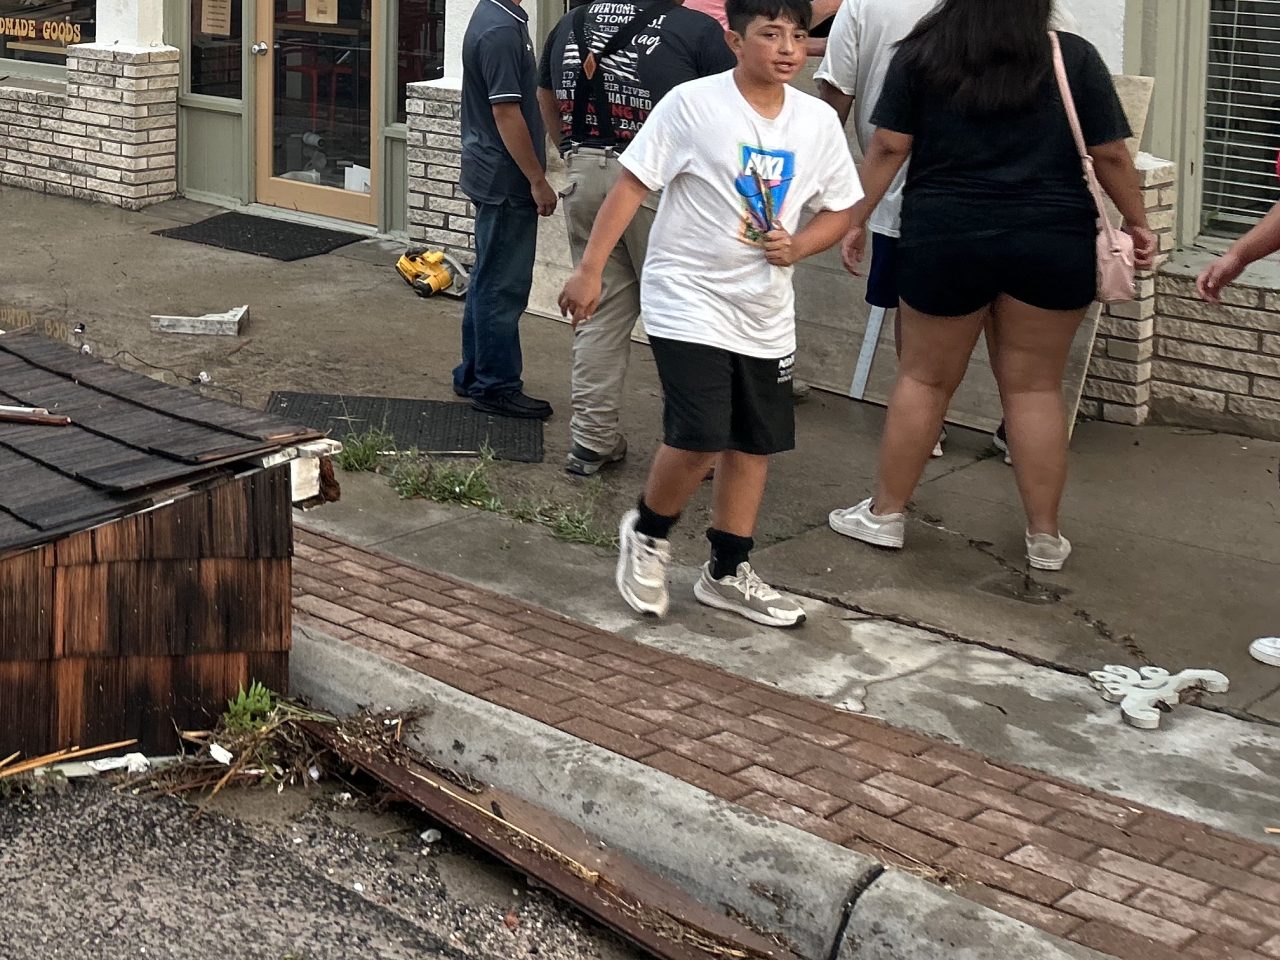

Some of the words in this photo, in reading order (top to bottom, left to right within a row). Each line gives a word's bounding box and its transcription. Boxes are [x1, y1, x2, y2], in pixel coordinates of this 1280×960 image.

[588, 3, 637, 15] EVERYONE
[42, 20, 81, 43] GOODS
[598, 24, 619, 33] THIS
[622, 85, 651, 98] LIVES
[629, 95, 652, 111] DIED
